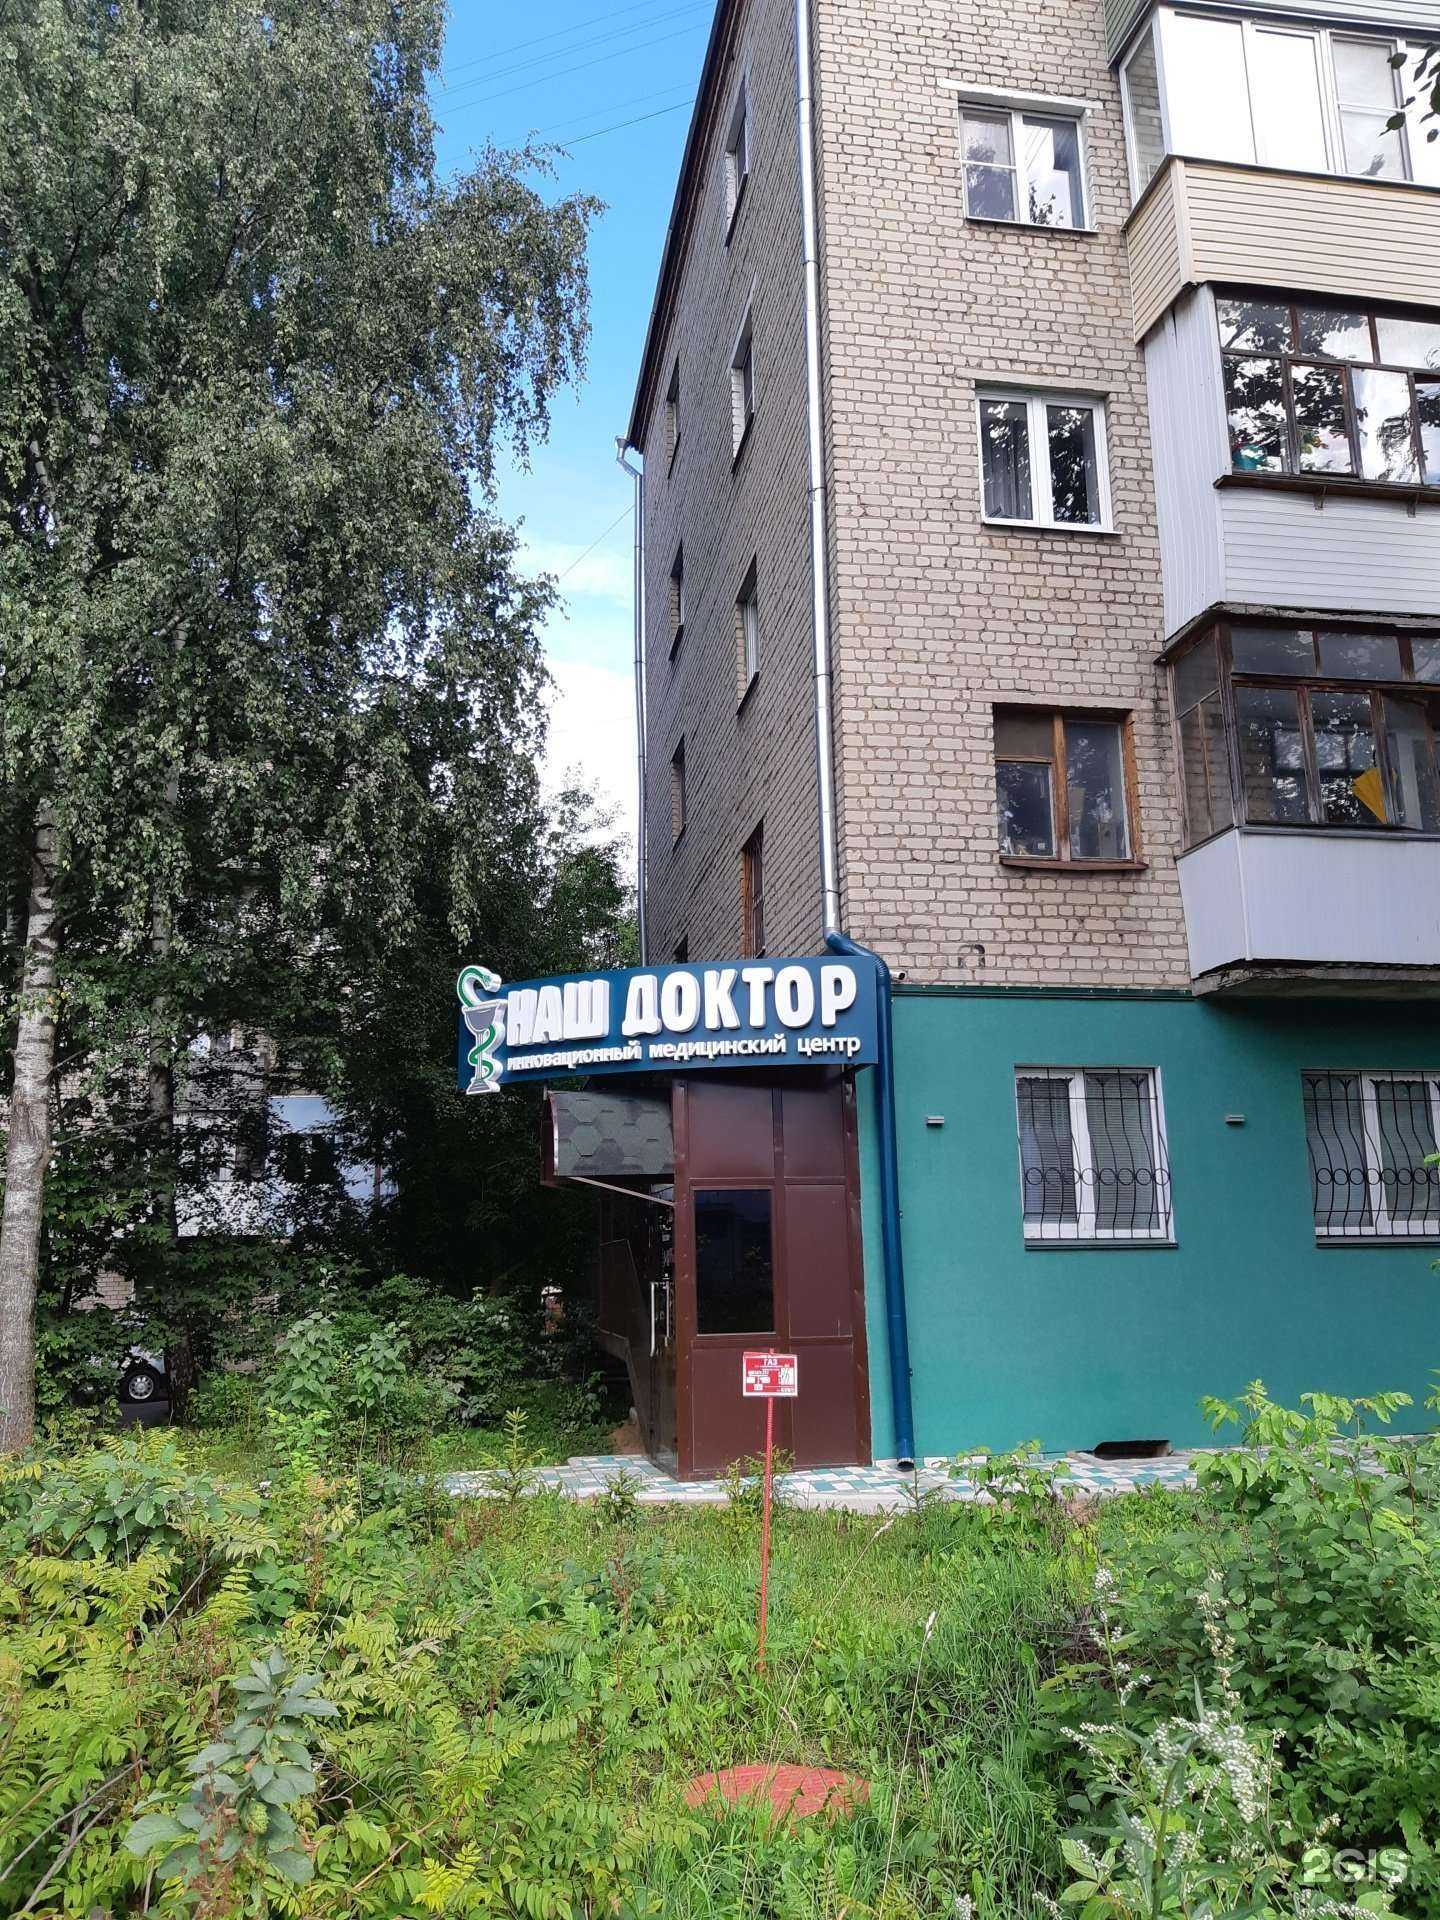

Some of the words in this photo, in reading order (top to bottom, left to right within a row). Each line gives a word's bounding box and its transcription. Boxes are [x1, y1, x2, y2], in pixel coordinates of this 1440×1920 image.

[507, 979, 609, 1046] НАШ
[622, 965, 857, 1037] ДОКТОР
[507, 1040, 642, 1071] инновационный
[649, 1033, 787, 1061] медицинский
[797, 1036, 861, 1057] центр
[763, 1358, 778, 1366] ГАЗ
